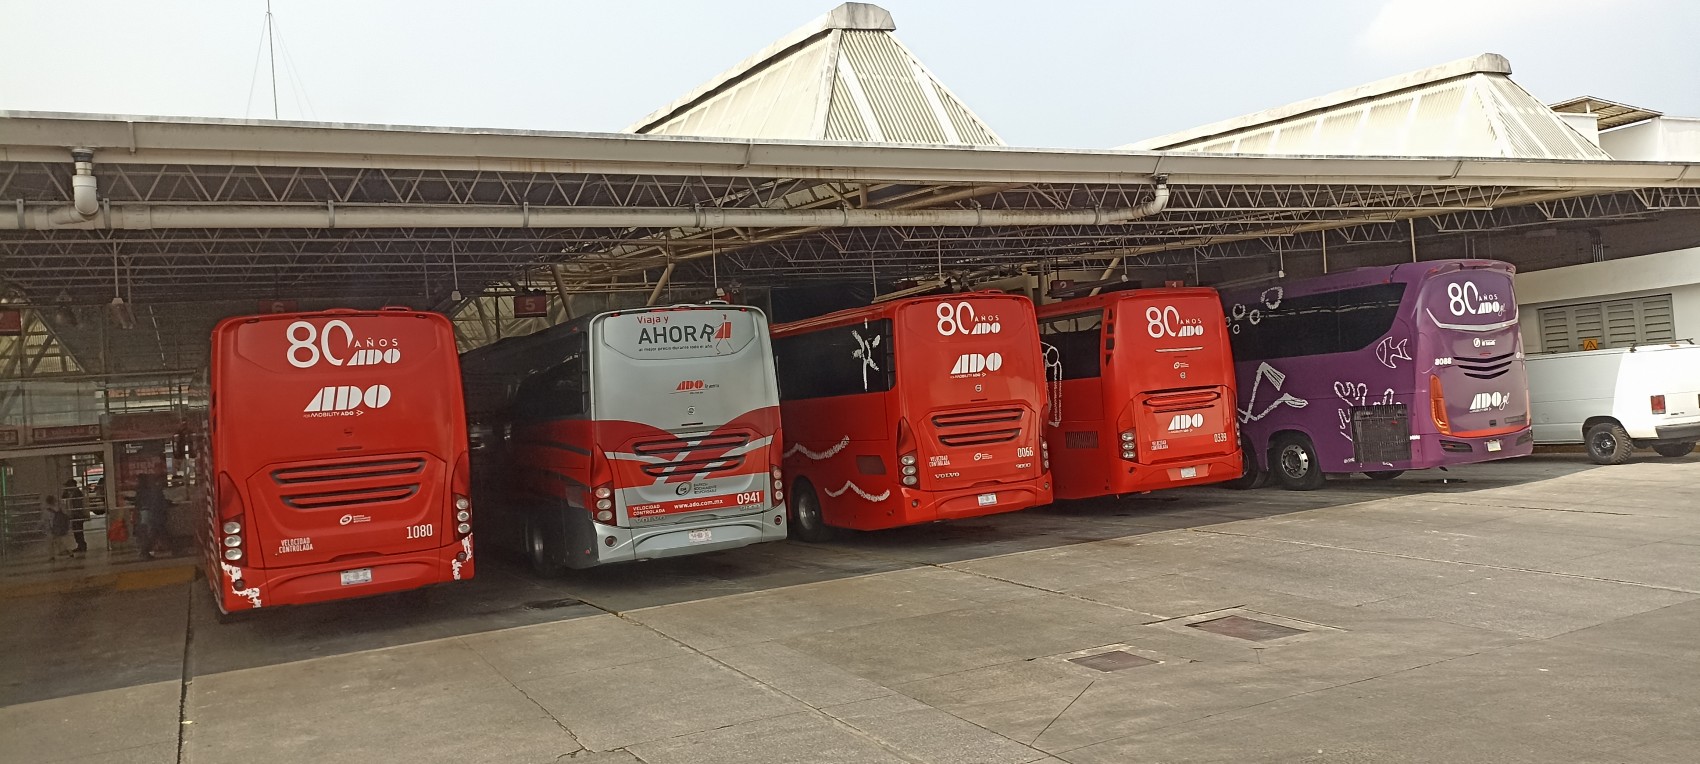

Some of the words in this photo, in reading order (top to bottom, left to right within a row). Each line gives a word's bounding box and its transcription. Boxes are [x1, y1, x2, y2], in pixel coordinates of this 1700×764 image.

[525, 298, 536, 311] 5
[1447, 281, 1478, 316] 80
[637, 315, 661, 324] Viaja
[664, 315, 669, 323] y
[936, 301, 975, 336] 80
[1146, 305, 1180, 339] 80
[971, 322, 1001, 335] ADO
[1177, 324, 1204, 337] ADO
[286, 319, 354, 368] 80
[354, 338, 398, 348] AÑOS
[346, 348, 401, 366] ADO
[950, 352, 1003, 375] ADO
[675, 379, 704, 391] ADO
[303, 384, 392, 412] ADO
[1167, 413, 1204, 431] ADO
[935, 471, 960, 479] VOLVO
[673, 499, 724, 509] www.ado.com.mx
[736, 491, 760, 505] 0941
[632, 508, 666, 516] CONTROLADA
[406, 523, 433, 539] 1080
[278, 543, 314, 554] CONTROLADA
[280, 537, 311, 547] VELOCIDAD
